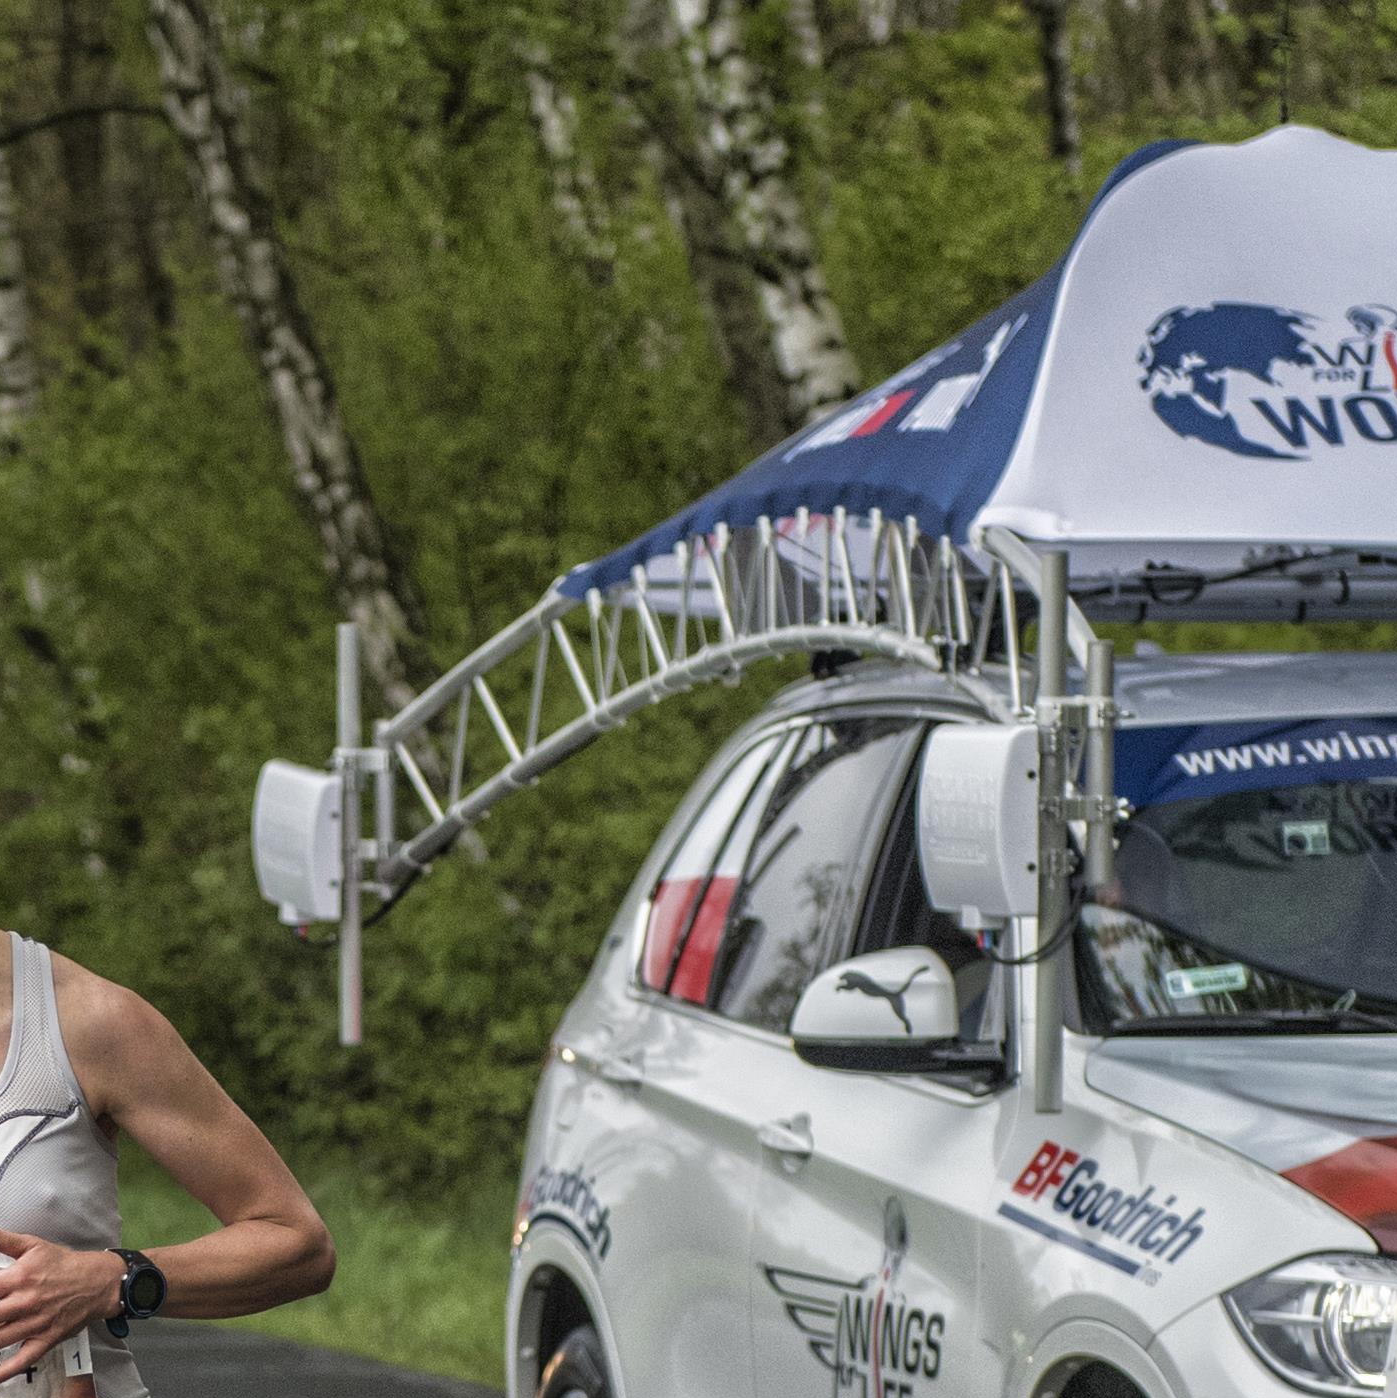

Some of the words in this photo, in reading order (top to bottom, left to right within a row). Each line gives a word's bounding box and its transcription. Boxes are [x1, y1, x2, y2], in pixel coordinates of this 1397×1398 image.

[1312, 370, 1357, 384] FOR
[1012, 1140, 1206, 1264] BFGoodrich
[72, 1351, 82, 1370] 1
[838, 1290, 946, 1381] WINGS
